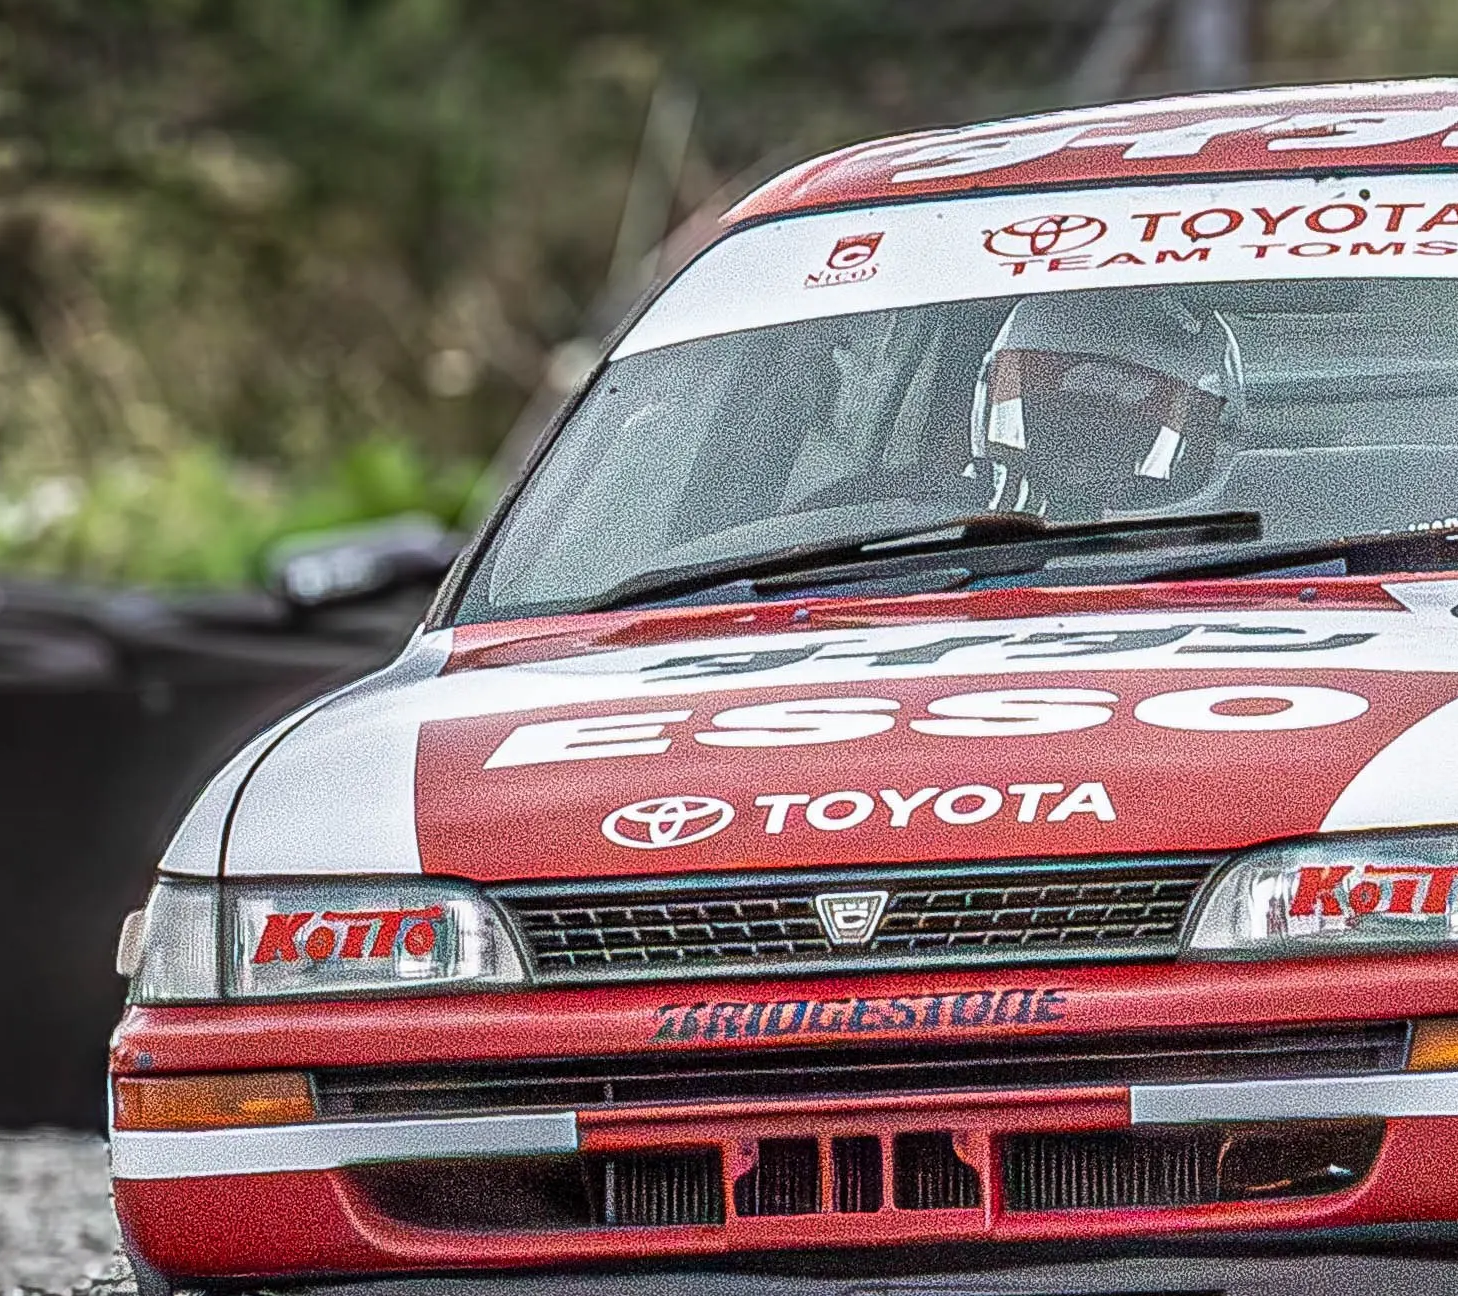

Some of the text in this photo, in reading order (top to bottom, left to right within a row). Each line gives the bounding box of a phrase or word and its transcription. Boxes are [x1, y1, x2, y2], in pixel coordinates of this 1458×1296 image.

[999, 240, 1458, 277] TEAM TOMS
[482, 684, 1370, 770] ESSO
[753, 781, 1116, 836] TOYOTA
[649, 988, 1075, 1044] BRIDGESTONE
